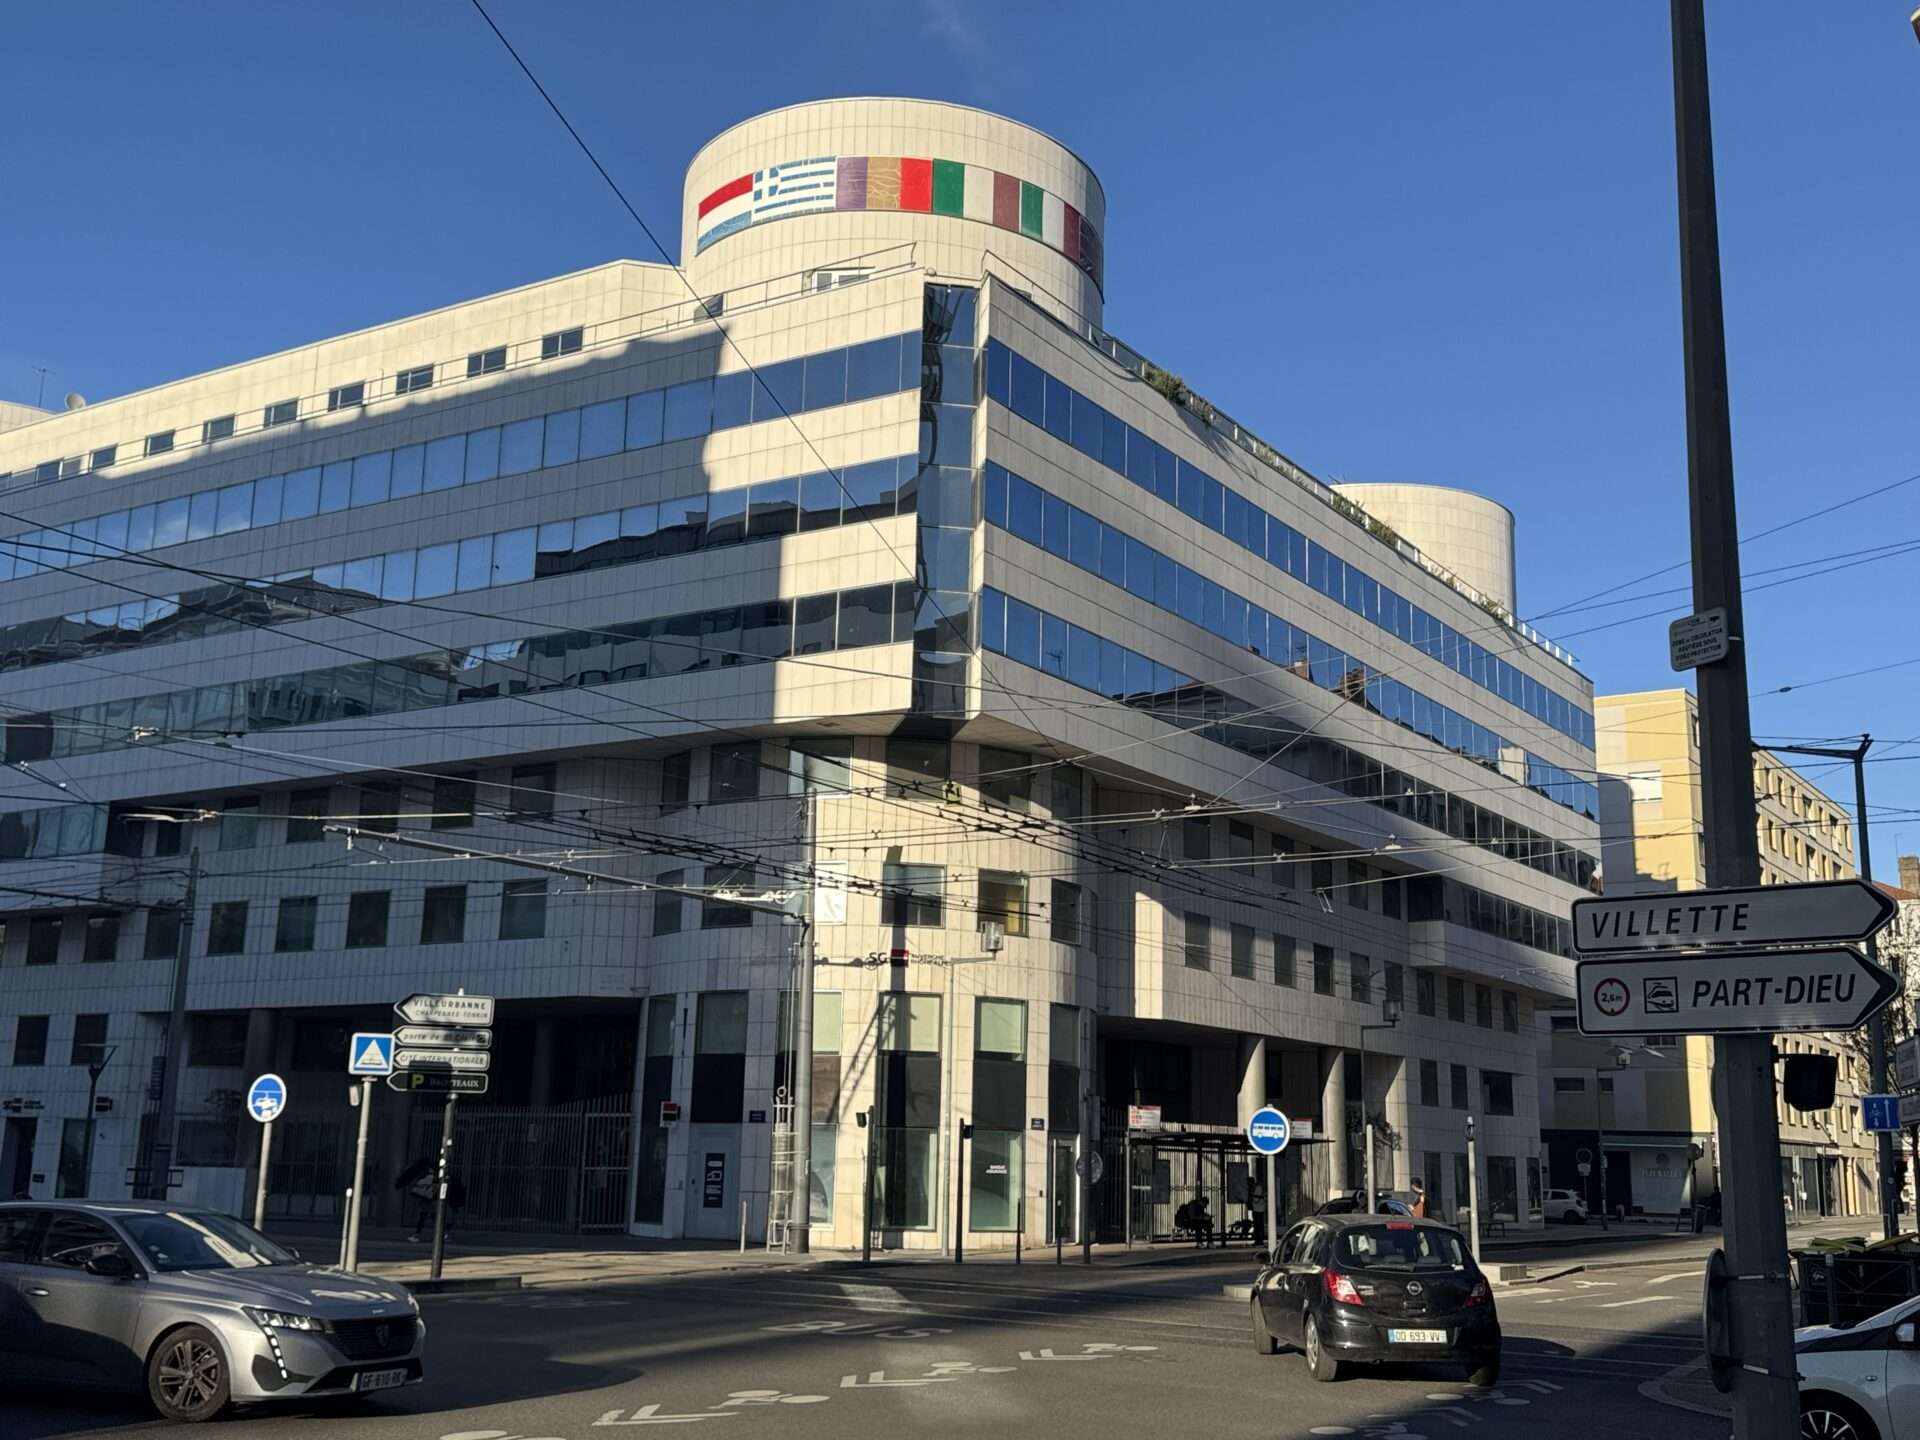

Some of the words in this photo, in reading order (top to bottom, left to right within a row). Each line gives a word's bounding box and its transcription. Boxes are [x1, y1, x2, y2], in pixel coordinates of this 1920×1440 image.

[1591, 903, 1749, 939] VILLETTE
[1692, 974, 1855, 1008] PART-DIEU
[413, 999, 487, 1010] VILLEURBANNE
[403, 1032, 427, 1041] porte
[431, 1032, 440, 1040] de
[411, 1073, 425, 1089] P
[759, 1320, 952, 1339] BUS
